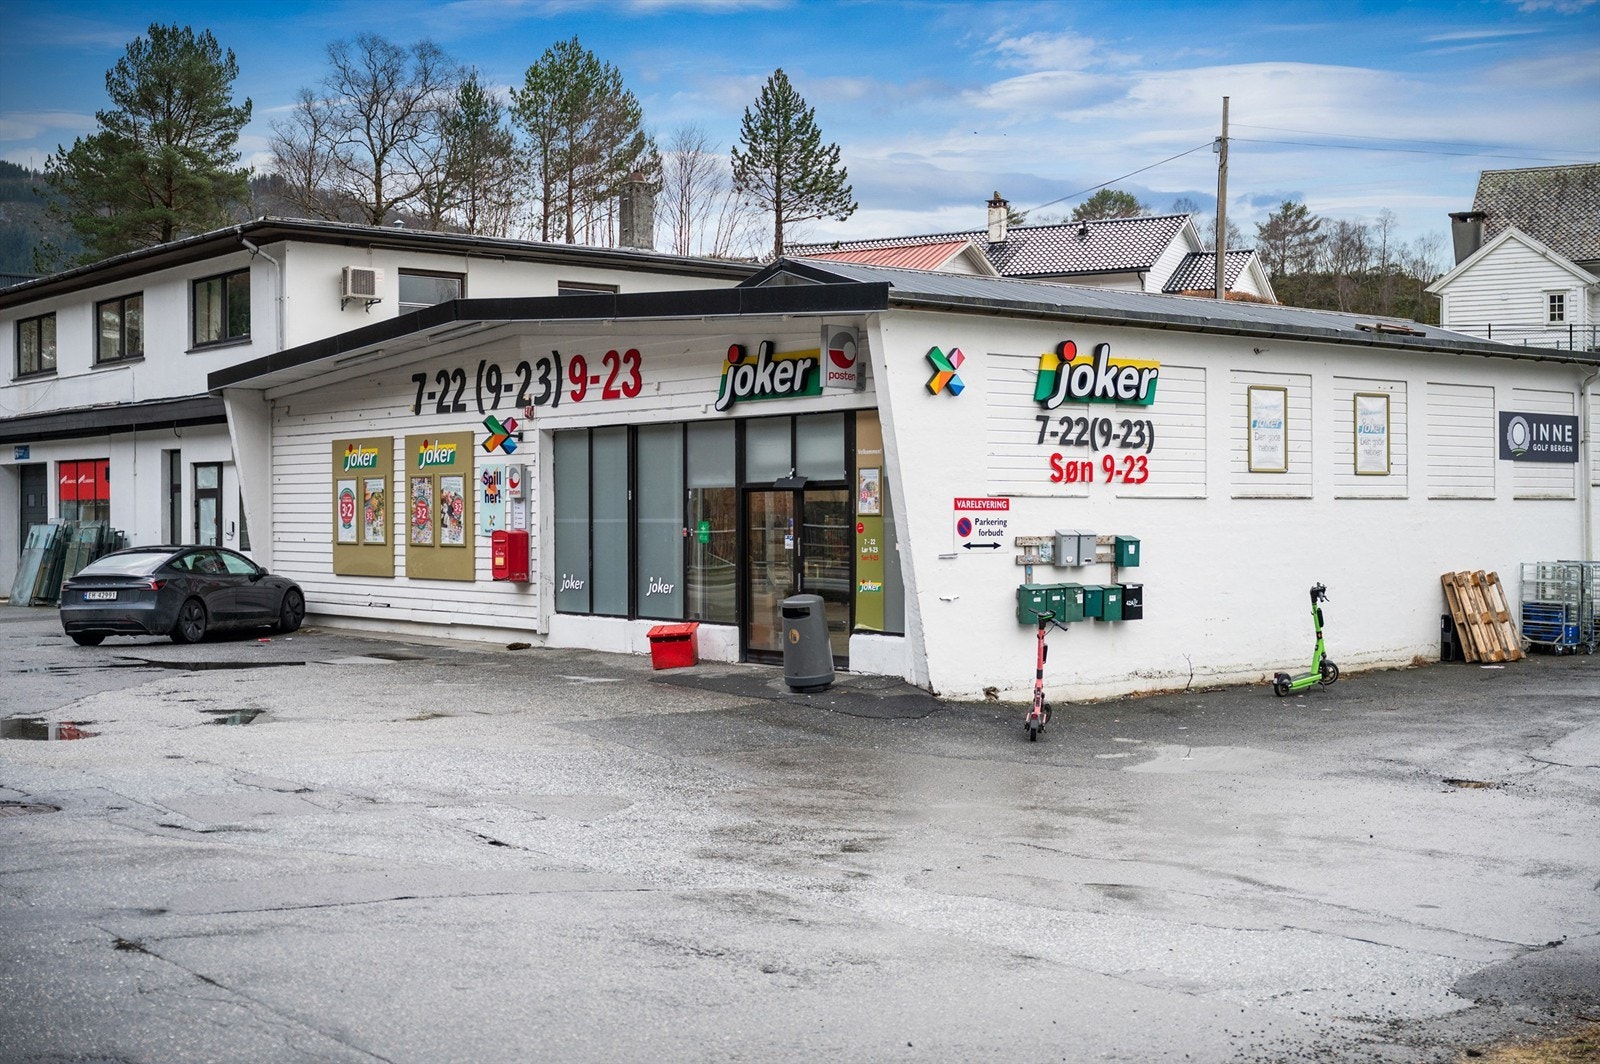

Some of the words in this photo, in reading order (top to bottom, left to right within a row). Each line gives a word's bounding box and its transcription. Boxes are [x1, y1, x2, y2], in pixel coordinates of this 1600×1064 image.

[411, 367, 468, 416] 7-22
[475, 350, 563, 415] (9-23)
[568, 348, 643, 403] 9-23
[715, 340, 816, 411] joker
[828, 370, 856, 381] posten
[1042, 340, 1159, 410] joker
[1036, 414, 1155, 454] 7-22(9-23)
[1532, 422, 1572, 442] INNE
[344, 443, 376, 472] joker
[419, 439, 455, 469] joker
[1532, 444, 1548, 452] GOLF
[1050, 453, 1094, 484] Søn
[1102, 454, 1149, 484] 9-23
[482, 470, 502, 488] Spill
[484, 490, 501, 504] her!
[956, 500, 1007, 509] VARELEVERING
[974, 517, 1008, 528] Parkering
[978, 528, 1004, 537] forbudt
[560, 573, 585, 592] joker
[646, 576, 674, 596] joker
[860, 579, 880, 592] joker
